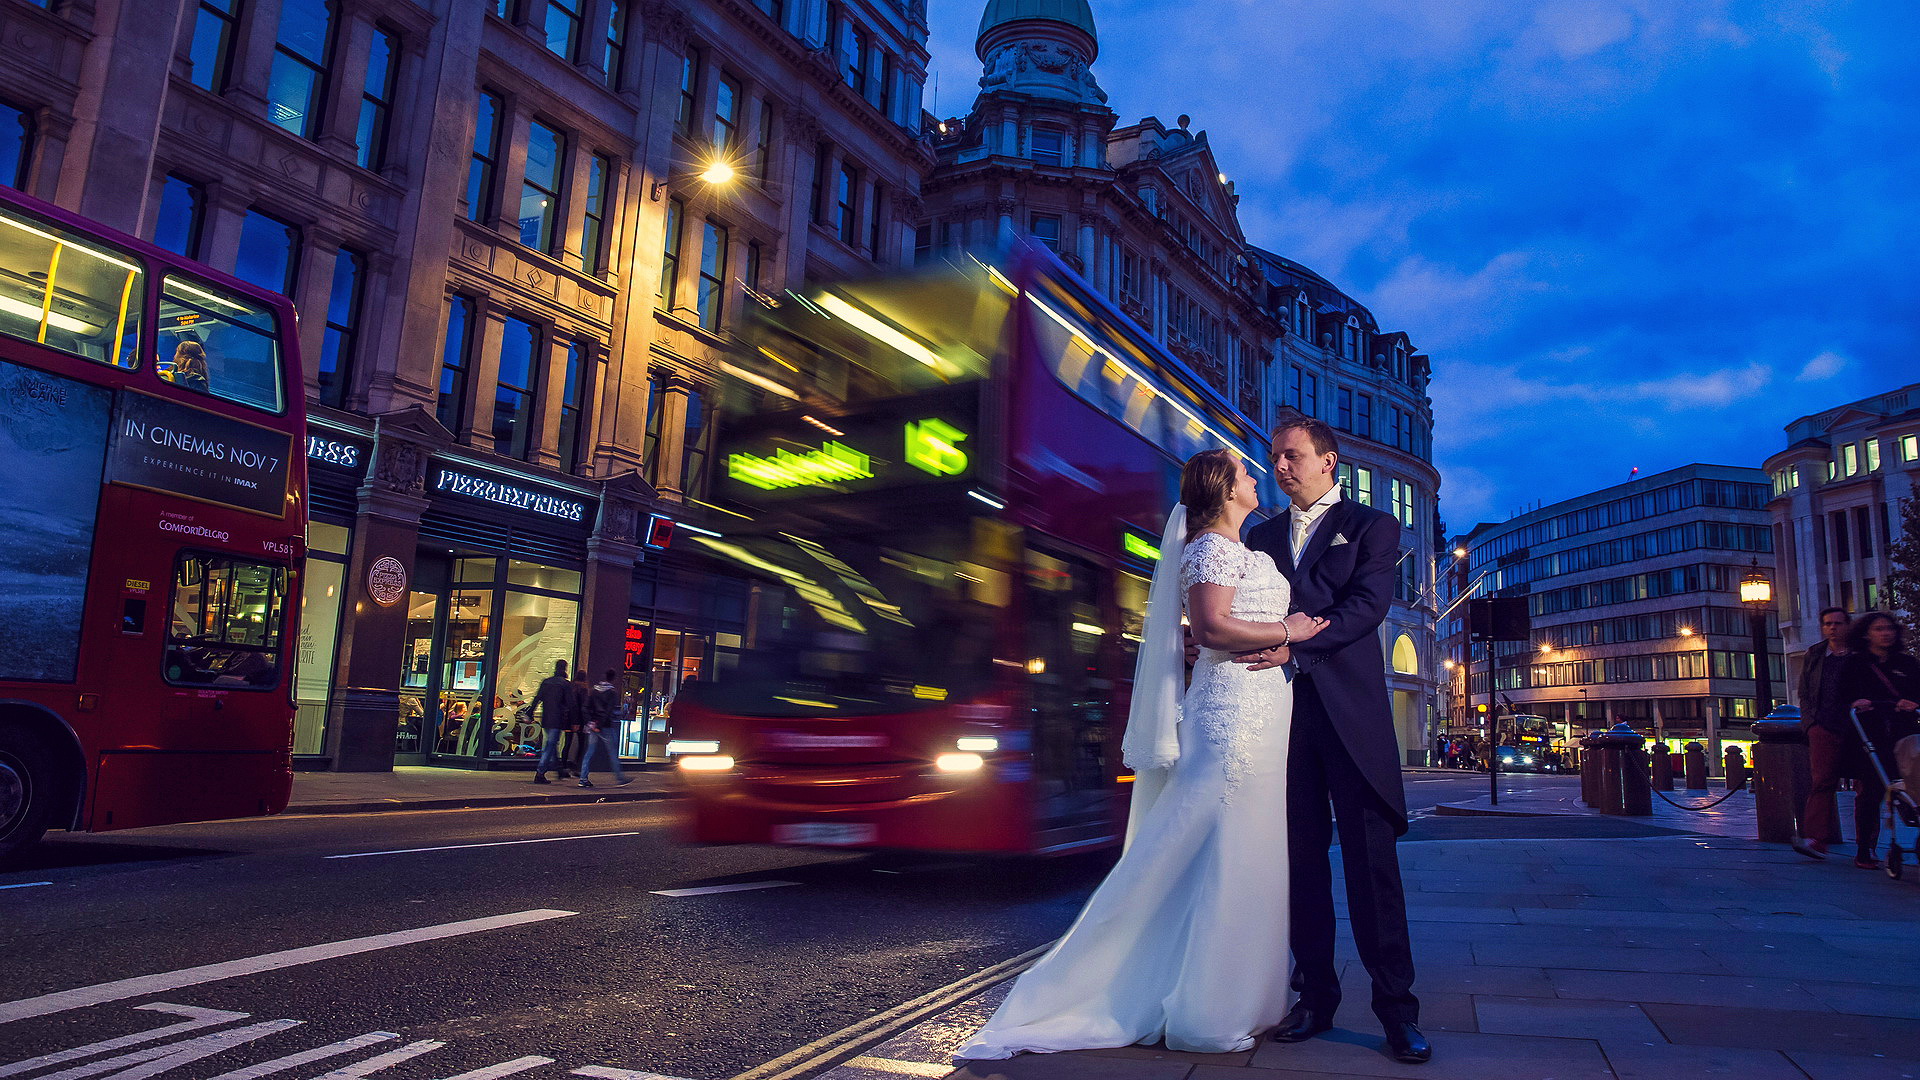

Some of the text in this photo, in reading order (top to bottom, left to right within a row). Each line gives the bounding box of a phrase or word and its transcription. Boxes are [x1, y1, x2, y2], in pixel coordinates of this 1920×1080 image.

[27, 381, 68, 397] MICHAEL
[28, 388, 66, 406] CAINE
[125, 419, 279, 473] IN CINEMAS NOV 7
[143, 456, 258, 490] EXPERIENCE IT IN IMAX
[165, 511, 188, 521] member
[126, 580, 148, 589] DIESEL
